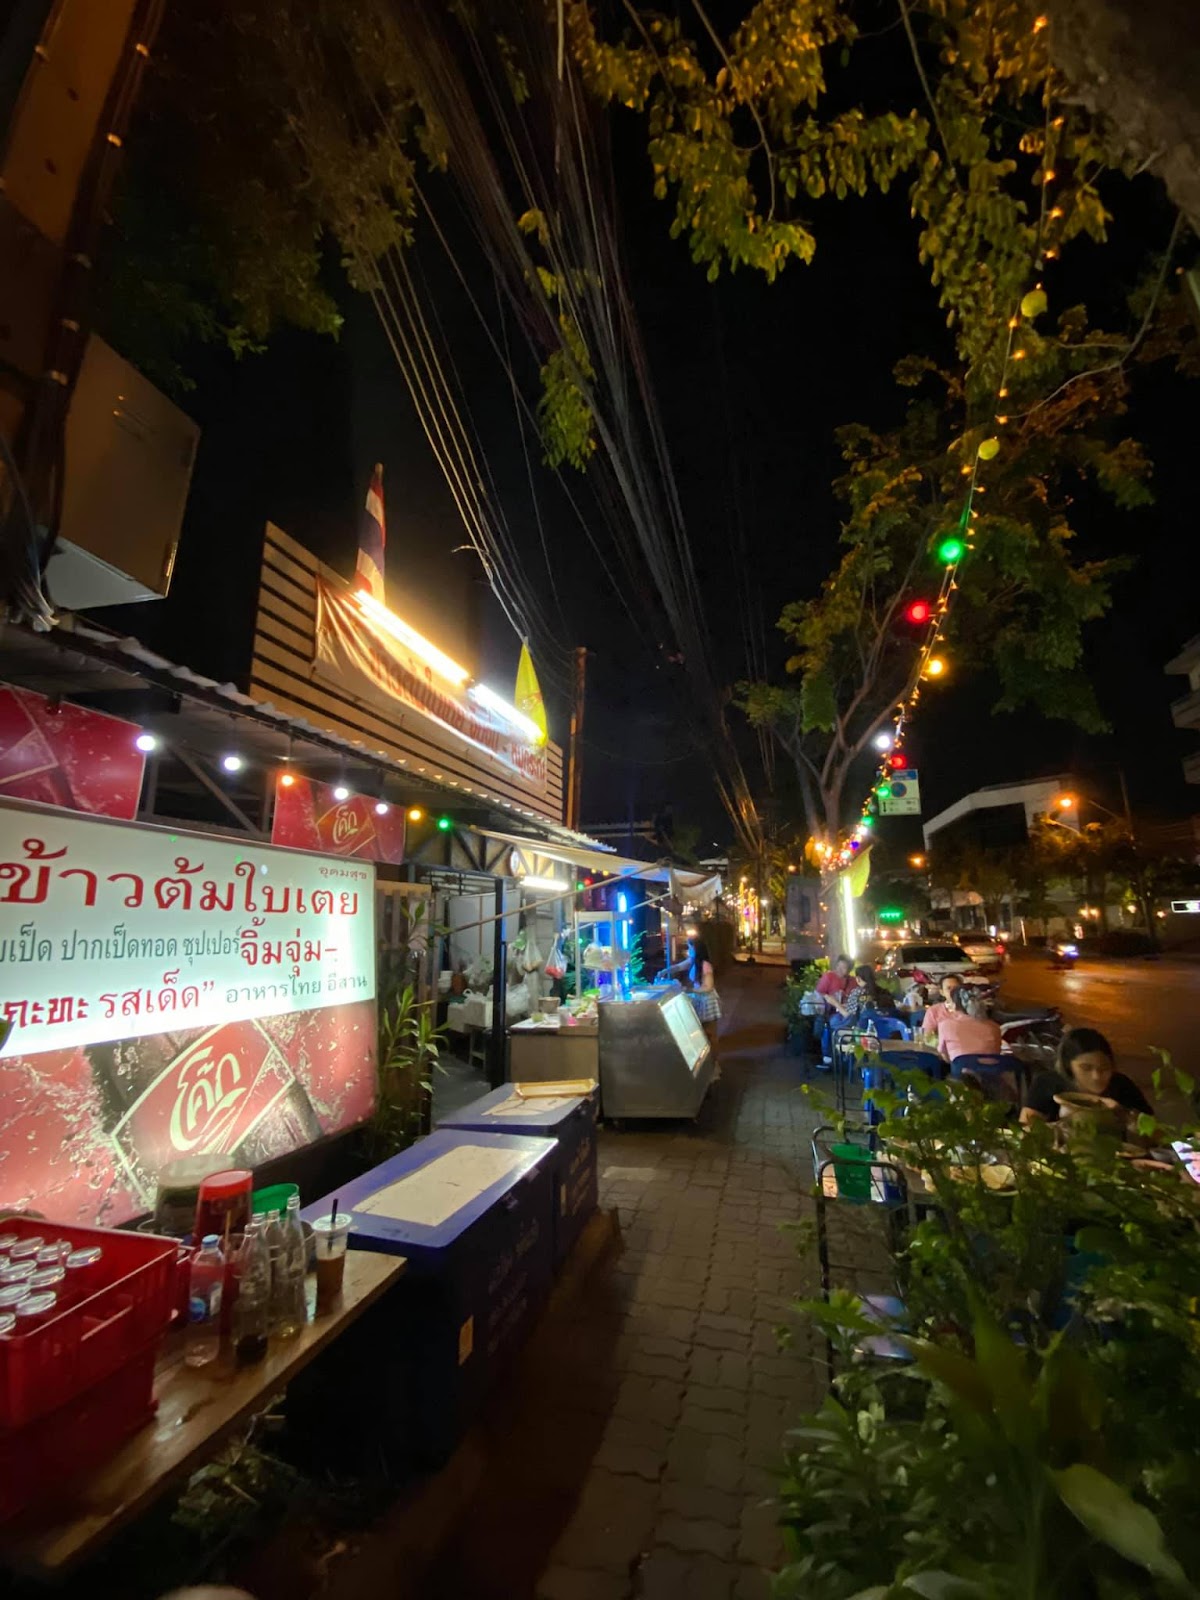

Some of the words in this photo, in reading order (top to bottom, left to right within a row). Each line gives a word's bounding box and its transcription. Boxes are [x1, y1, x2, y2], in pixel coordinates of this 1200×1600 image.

[0, 838, 358, 914] ข้าวต้มใบเตย
[61, 922, 177, 961] ปากเป็ดทอด
[183, 926, 242, 966] ซุปเปอร์
[226, 974, 322, 1003] อาหารไทย
[327, 972, 368, 991] อีสาน
[0, 996, 89, 1028] กะทะ
